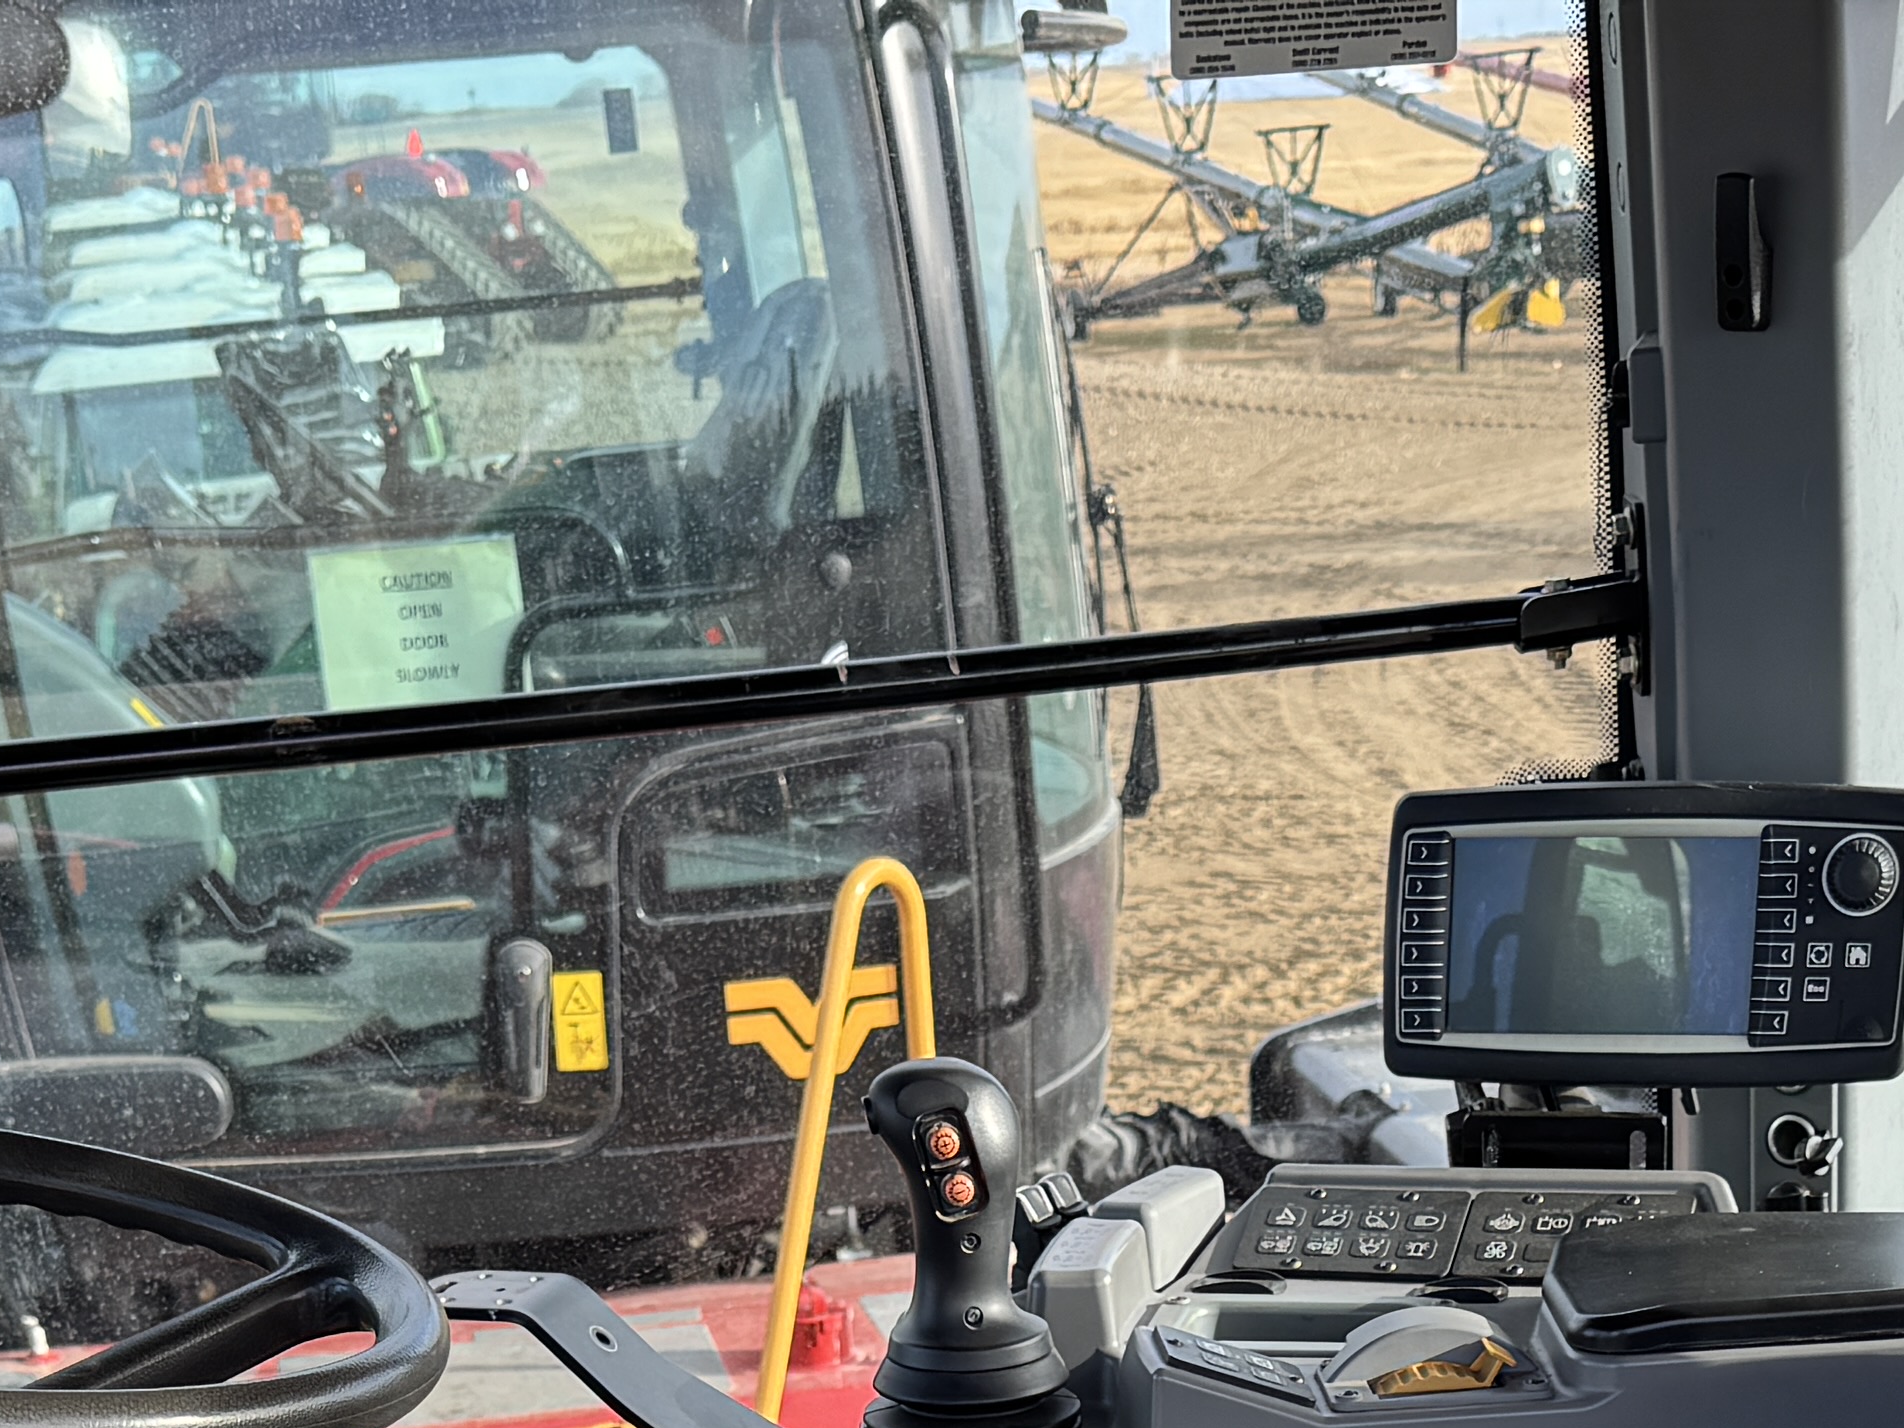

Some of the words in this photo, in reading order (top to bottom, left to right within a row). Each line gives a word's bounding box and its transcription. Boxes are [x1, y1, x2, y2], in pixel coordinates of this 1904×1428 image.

[379, 570, 454, 592] CAUTION
[398, 602, 443, 620] OPEN
[394, 664, 461, 683] SLOWLY
